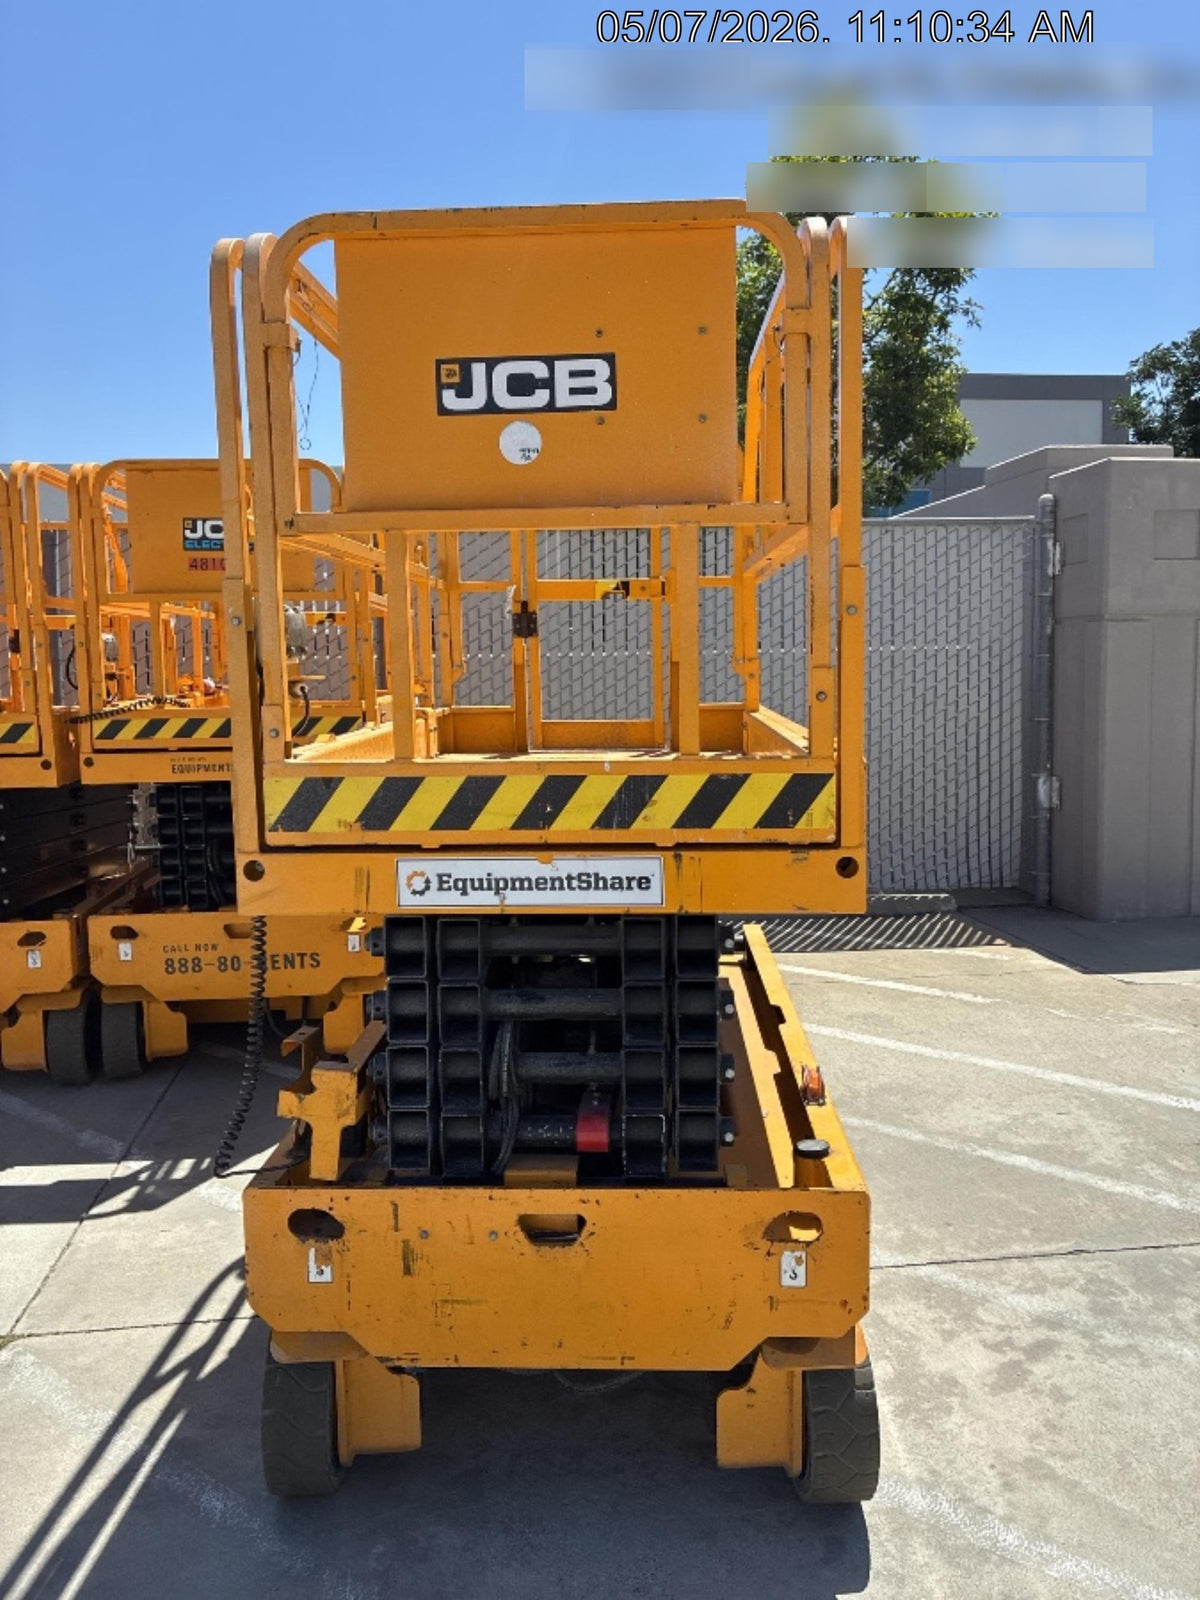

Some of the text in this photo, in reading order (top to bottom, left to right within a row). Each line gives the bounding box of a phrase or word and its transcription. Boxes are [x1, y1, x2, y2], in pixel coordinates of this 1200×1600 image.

[441, 358, 613, 411] JCB
[184, 520, 224, 539] JC
[185, 540, 224, 549] ELEC
[436, 872, 651, 896] EquipmentShare
[162, 943, 219, 954] CALL NOW
[164, 952, 321, 975] 888-80-ENTS
